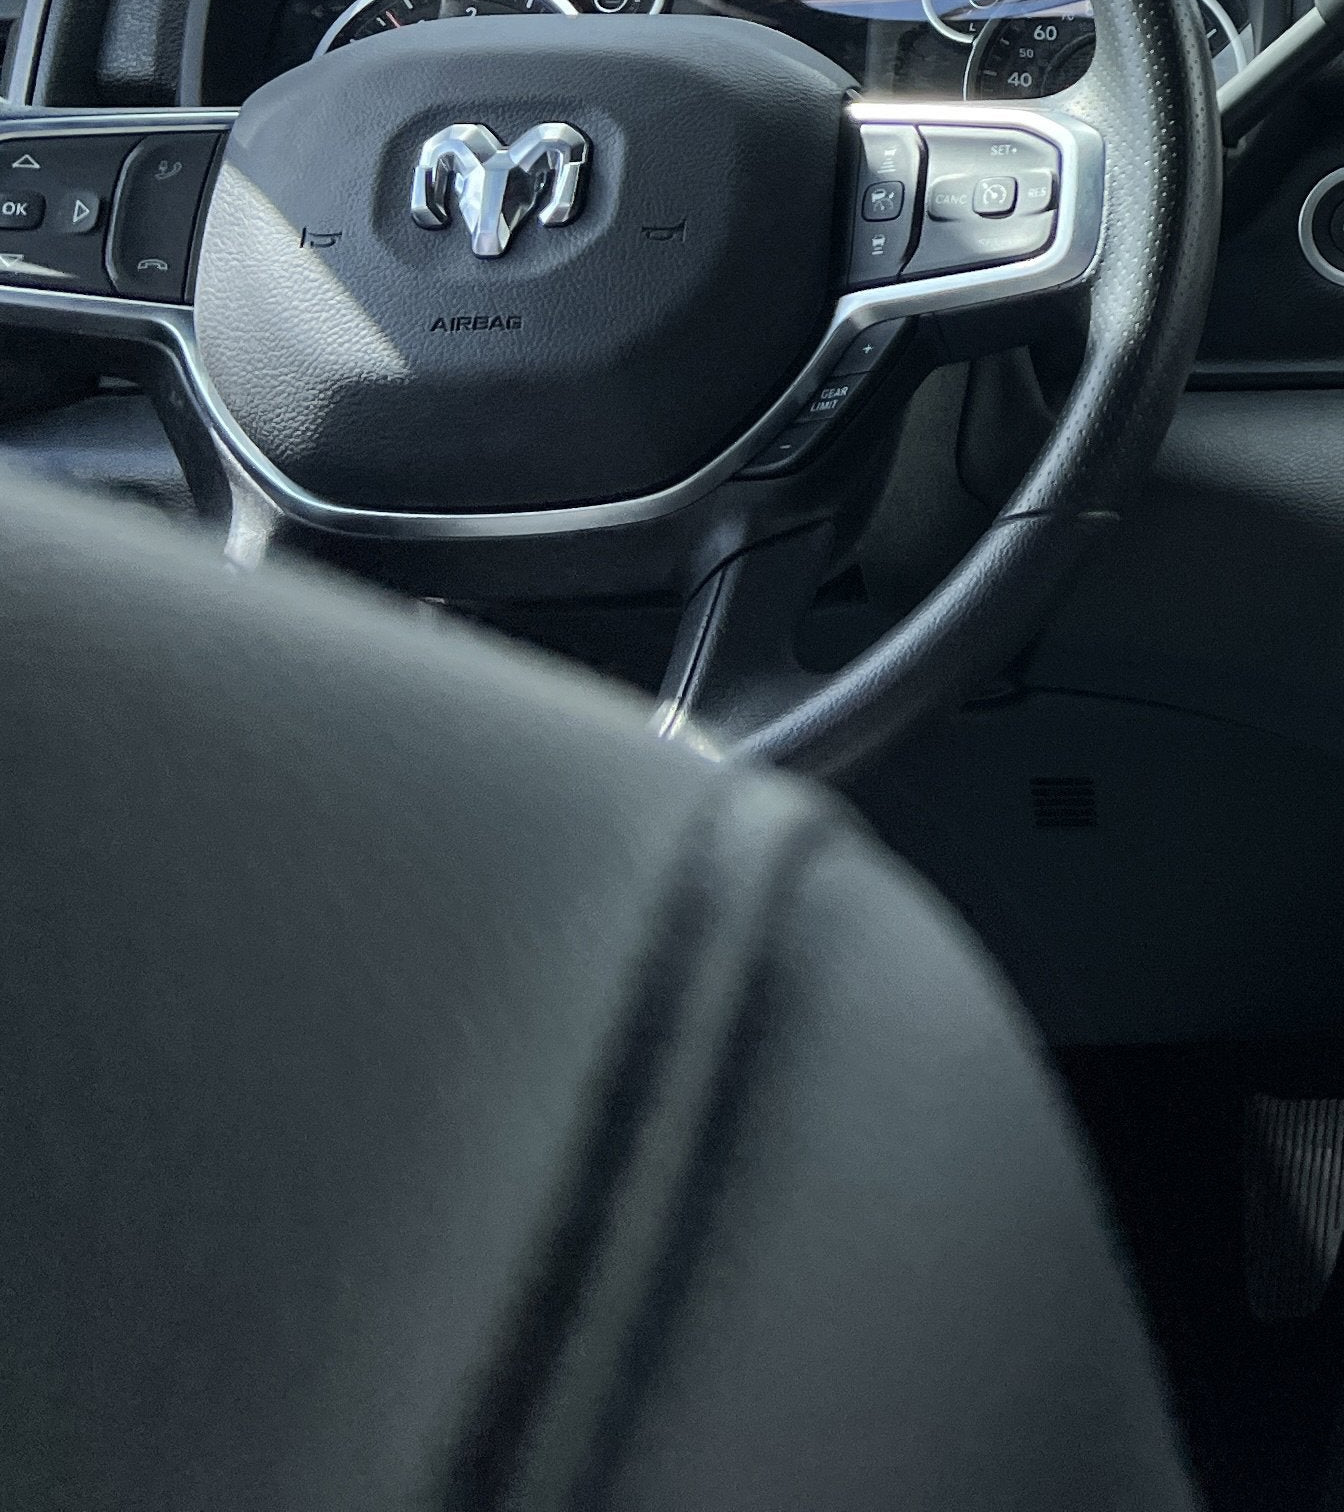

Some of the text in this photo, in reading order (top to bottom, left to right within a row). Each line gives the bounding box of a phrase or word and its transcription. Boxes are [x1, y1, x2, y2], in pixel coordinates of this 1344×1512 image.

[1033, 25, 1058, 41] 60
[1019, 48, 1034, 59] 50
[1007, 71, 1033, 88] 40
[935, 193, 969, 206] CANC
[2, 201, 28, 216] OK
[429, 314, 523, 332] AIRBAG
[821, 386, 849, 399] GEAR
[810, 399, 839, 412] LIMIT
